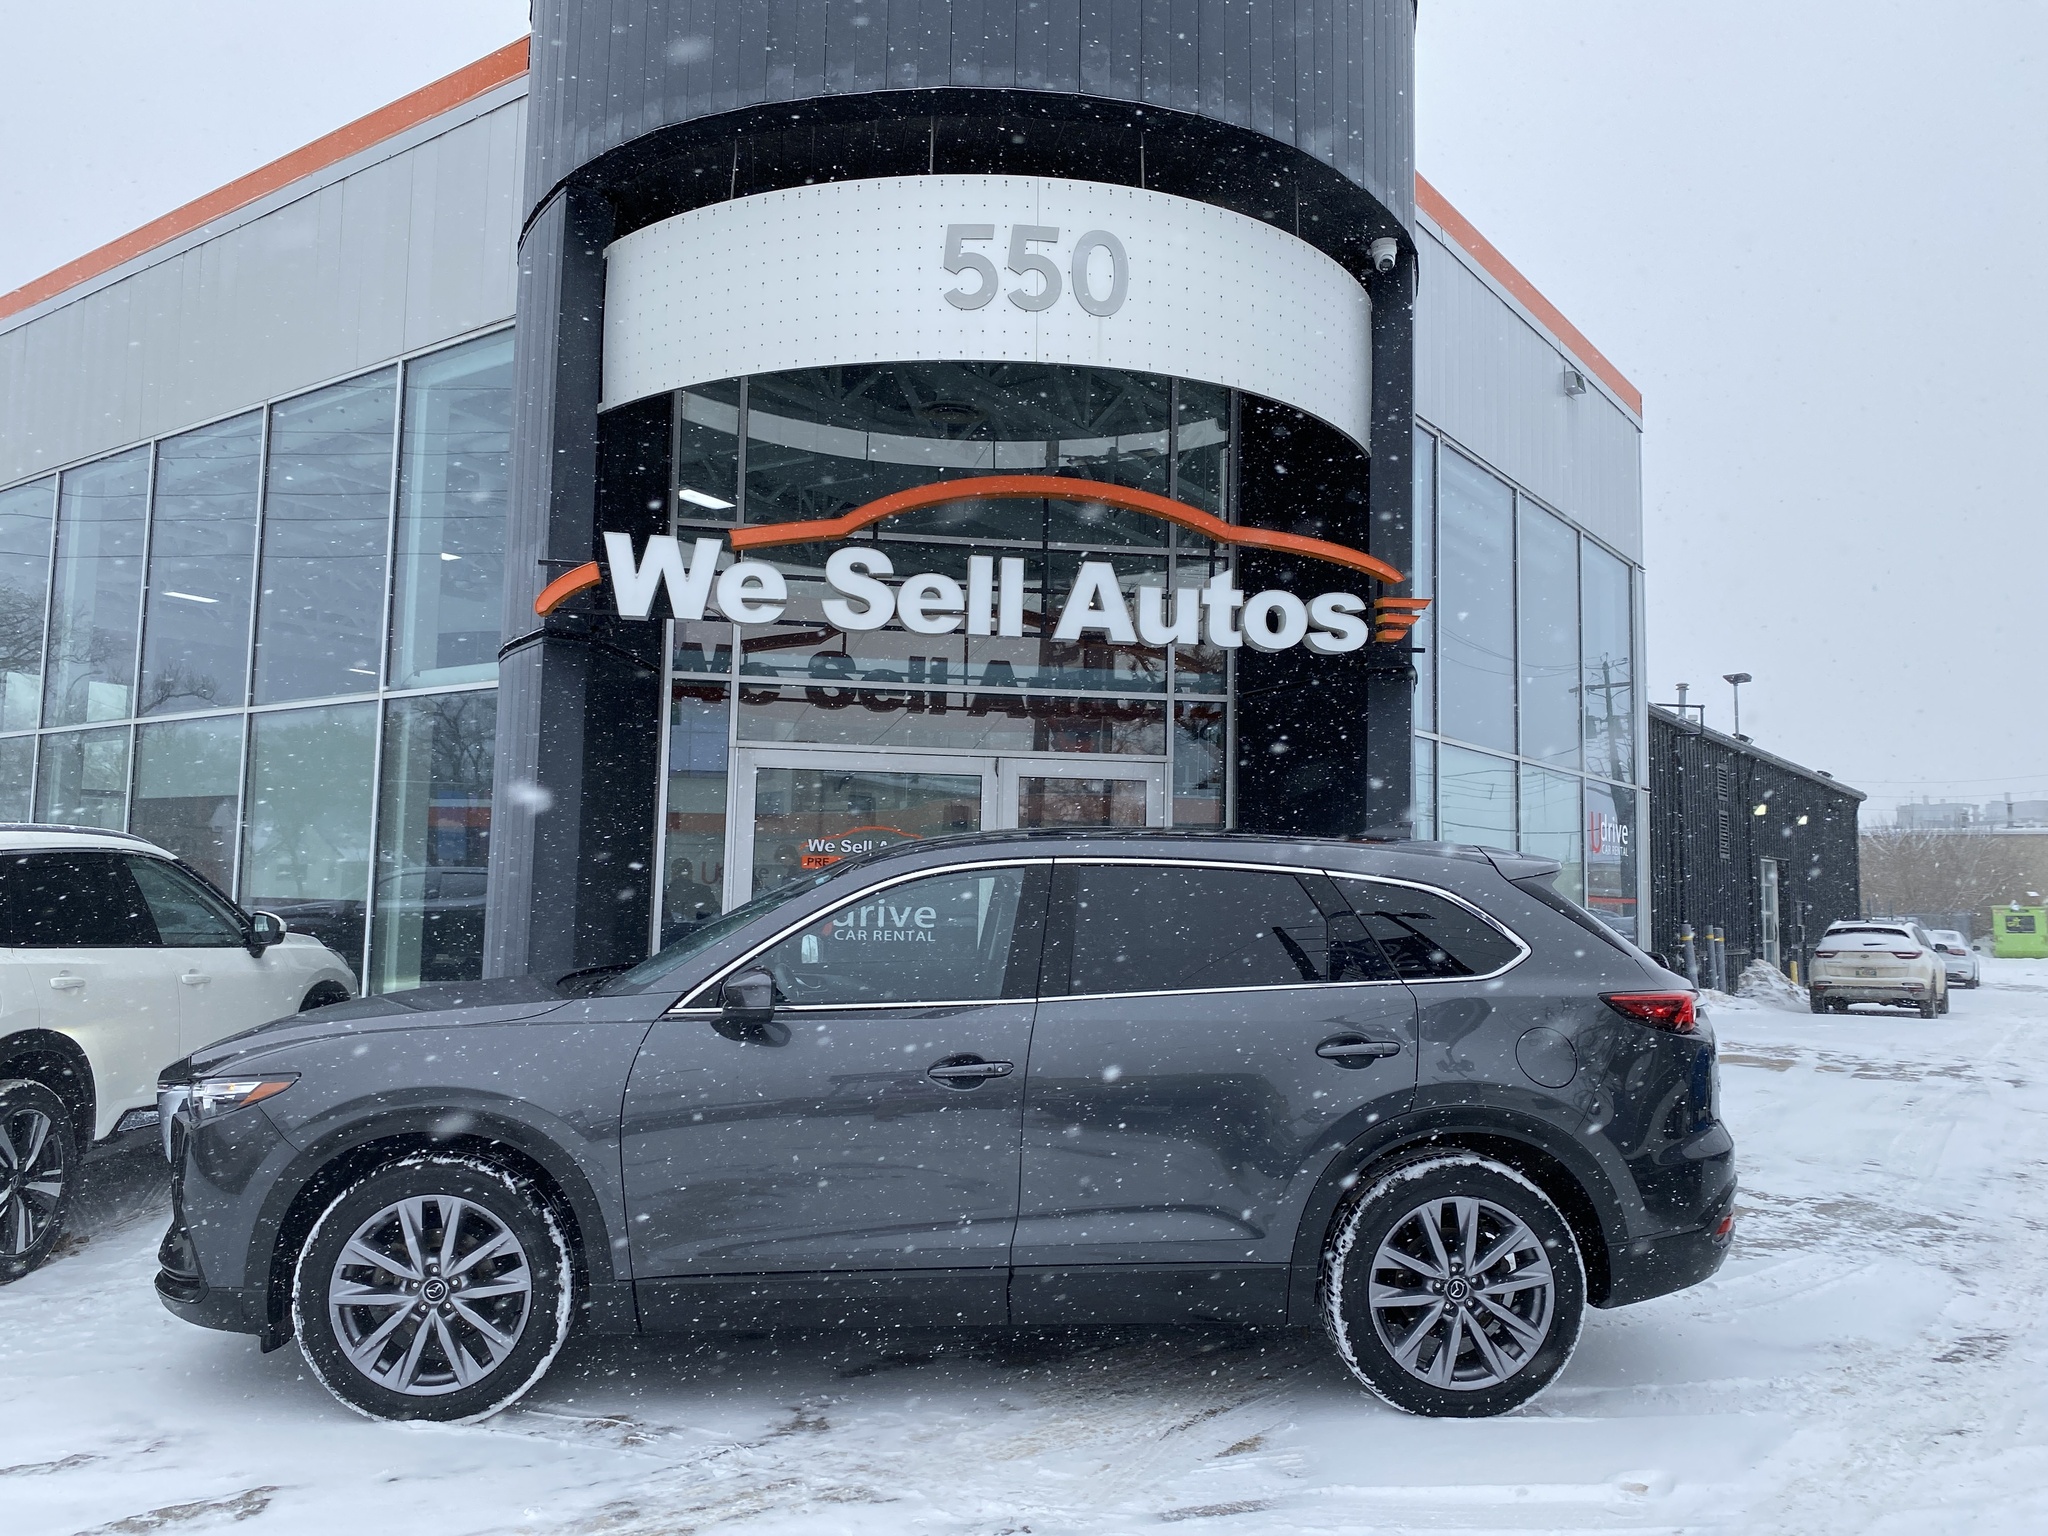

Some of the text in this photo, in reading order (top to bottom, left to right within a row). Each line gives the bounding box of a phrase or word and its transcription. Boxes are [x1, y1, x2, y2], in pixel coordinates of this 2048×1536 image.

[943, 223, 1129, 318] 550
[603, 531, 1369, 655] We Sell Autos
[808, 838, 836, 852] We
[840, 839, 873, 853] Sell
[1590, 811, 1629, 854] Udrive
[807, 857, 830, 867] PRE
[834, 929, 936, 942] CAR RENTAL
